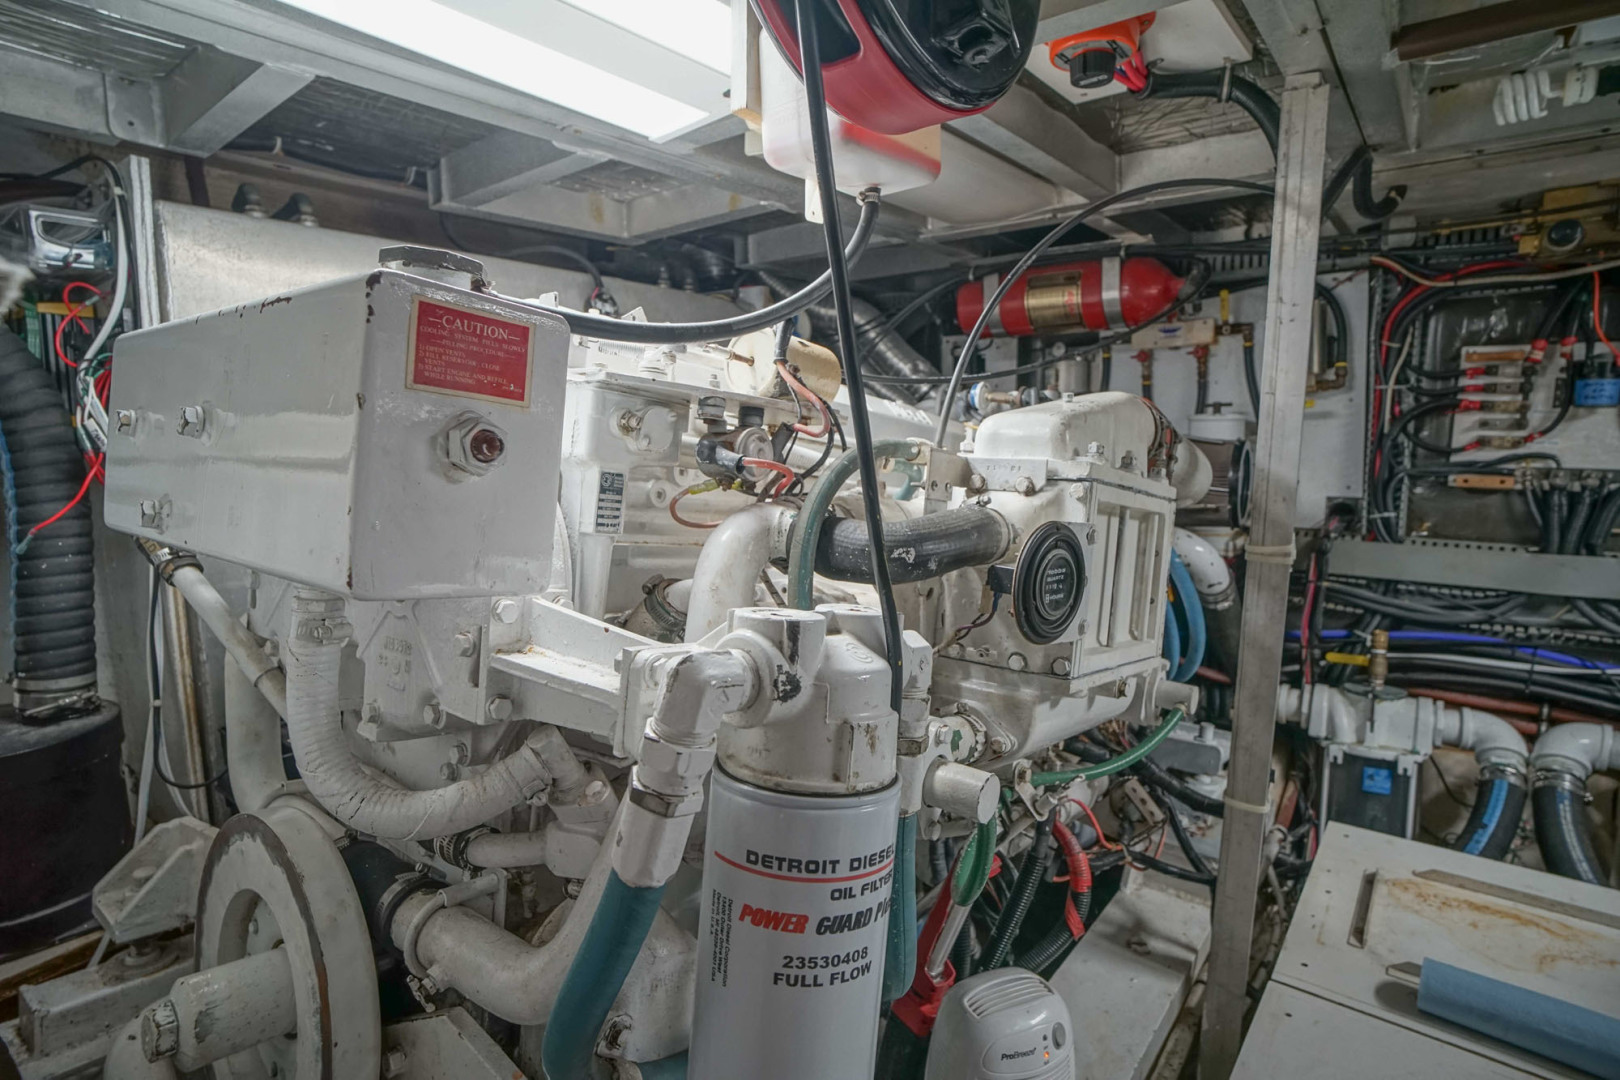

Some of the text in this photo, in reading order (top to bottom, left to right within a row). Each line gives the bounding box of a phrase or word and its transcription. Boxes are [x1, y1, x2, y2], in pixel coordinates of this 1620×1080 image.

[420, 325, 448, 336] COOLING
[454, 334, 478, 342] SYSTEM
[442, 315, 508, 340] CAUTION
[746, 845, 895, 874] DETROIT DIESEL
[831, 887, 856, 901] OIL
[738, 904, 809, 934] POWER
[816, 906, 873, 935] GUARD
[782, 947, 868, 969] 23530408
[773, 961, 872, 987] FULL FLOW
